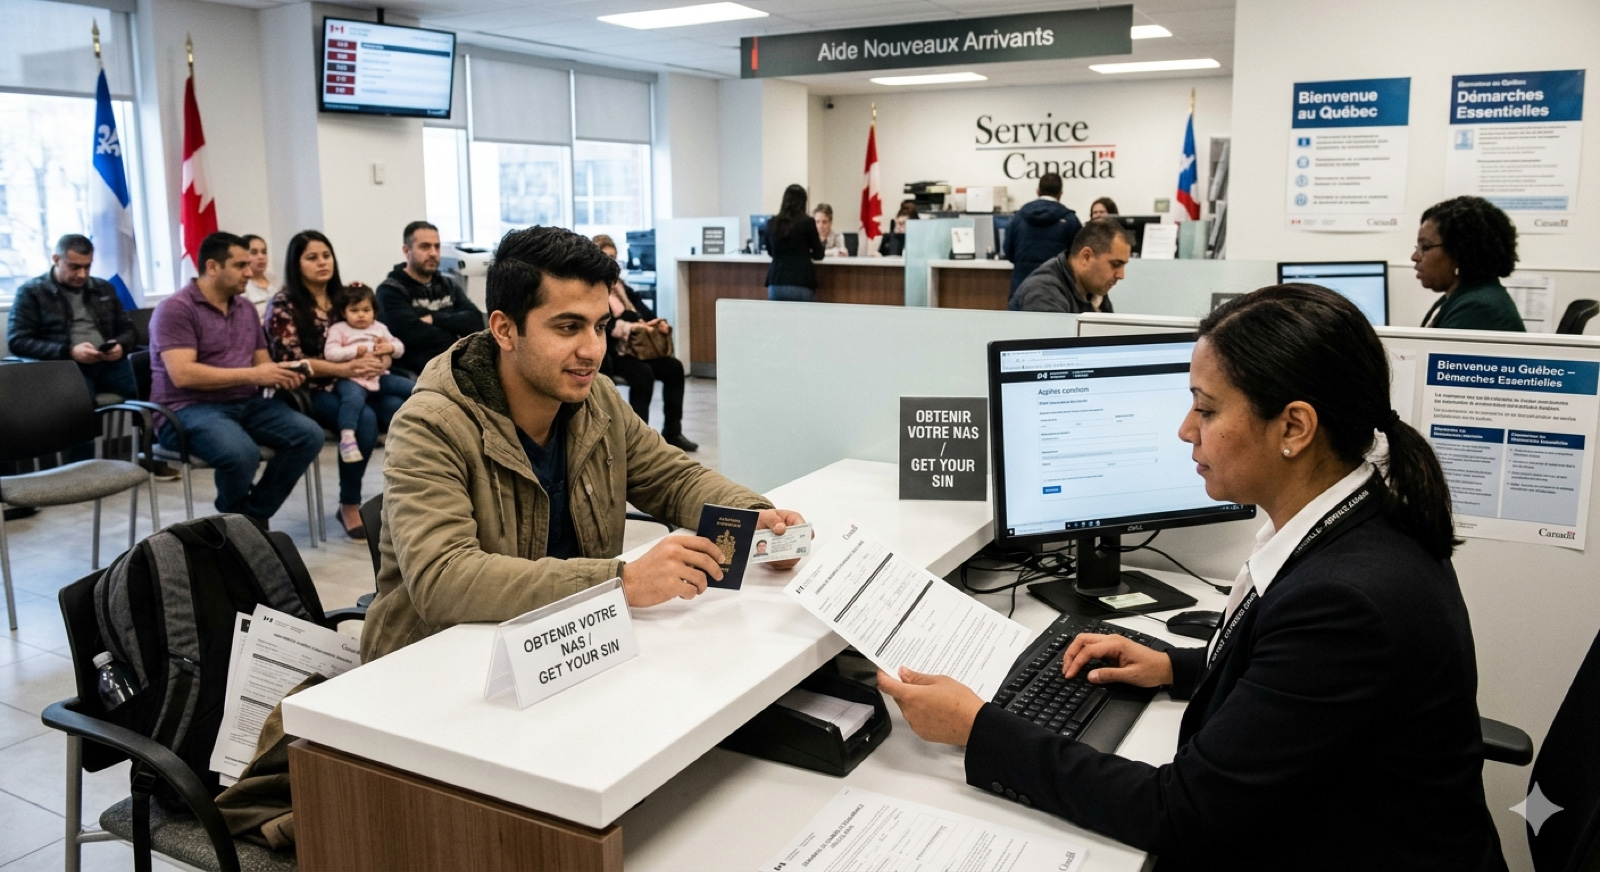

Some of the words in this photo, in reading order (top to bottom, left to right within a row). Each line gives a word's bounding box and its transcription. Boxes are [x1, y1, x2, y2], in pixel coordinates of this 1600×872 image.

[817, 42, 858, 62] Aide
[864, 37, 959, 58] Nouveaux
[963, 26, 1054, 52] Arrivants
[1298, 90, 1378, 104] Bienvenue
[1297, 109, 1316, 120] au
[1319, 105, 1378, 120] Québec
[1456, 104, 1550, 119] Essentielles
[975, 113, 1089, 145] Service
[1002, 151, 1116, 180] Canada
[1437, 360, 1499, 373] Bienvenue
[1500, 365, 1516, 374] au
[915, 409, 972, 423] OBTENIR
[907, 425, 950, 439] VOTRE
[952, 426, 979, 439] NAS
[940, 441, 947, 457] /
[910, 458, 936, 471] GET
[939, 458, 975, 472] YOUR
[931, 474, 954, 488] SIN
[523, 621, 578, 653] OBTENIR
[578, 604, 618, 630] VOTRE
[560, 636, 586, 656] NAS
[539, 663, 562, 685] GET
[565, 648, 599, 672] YOUR
[600, 638, 620, 657] SIN
